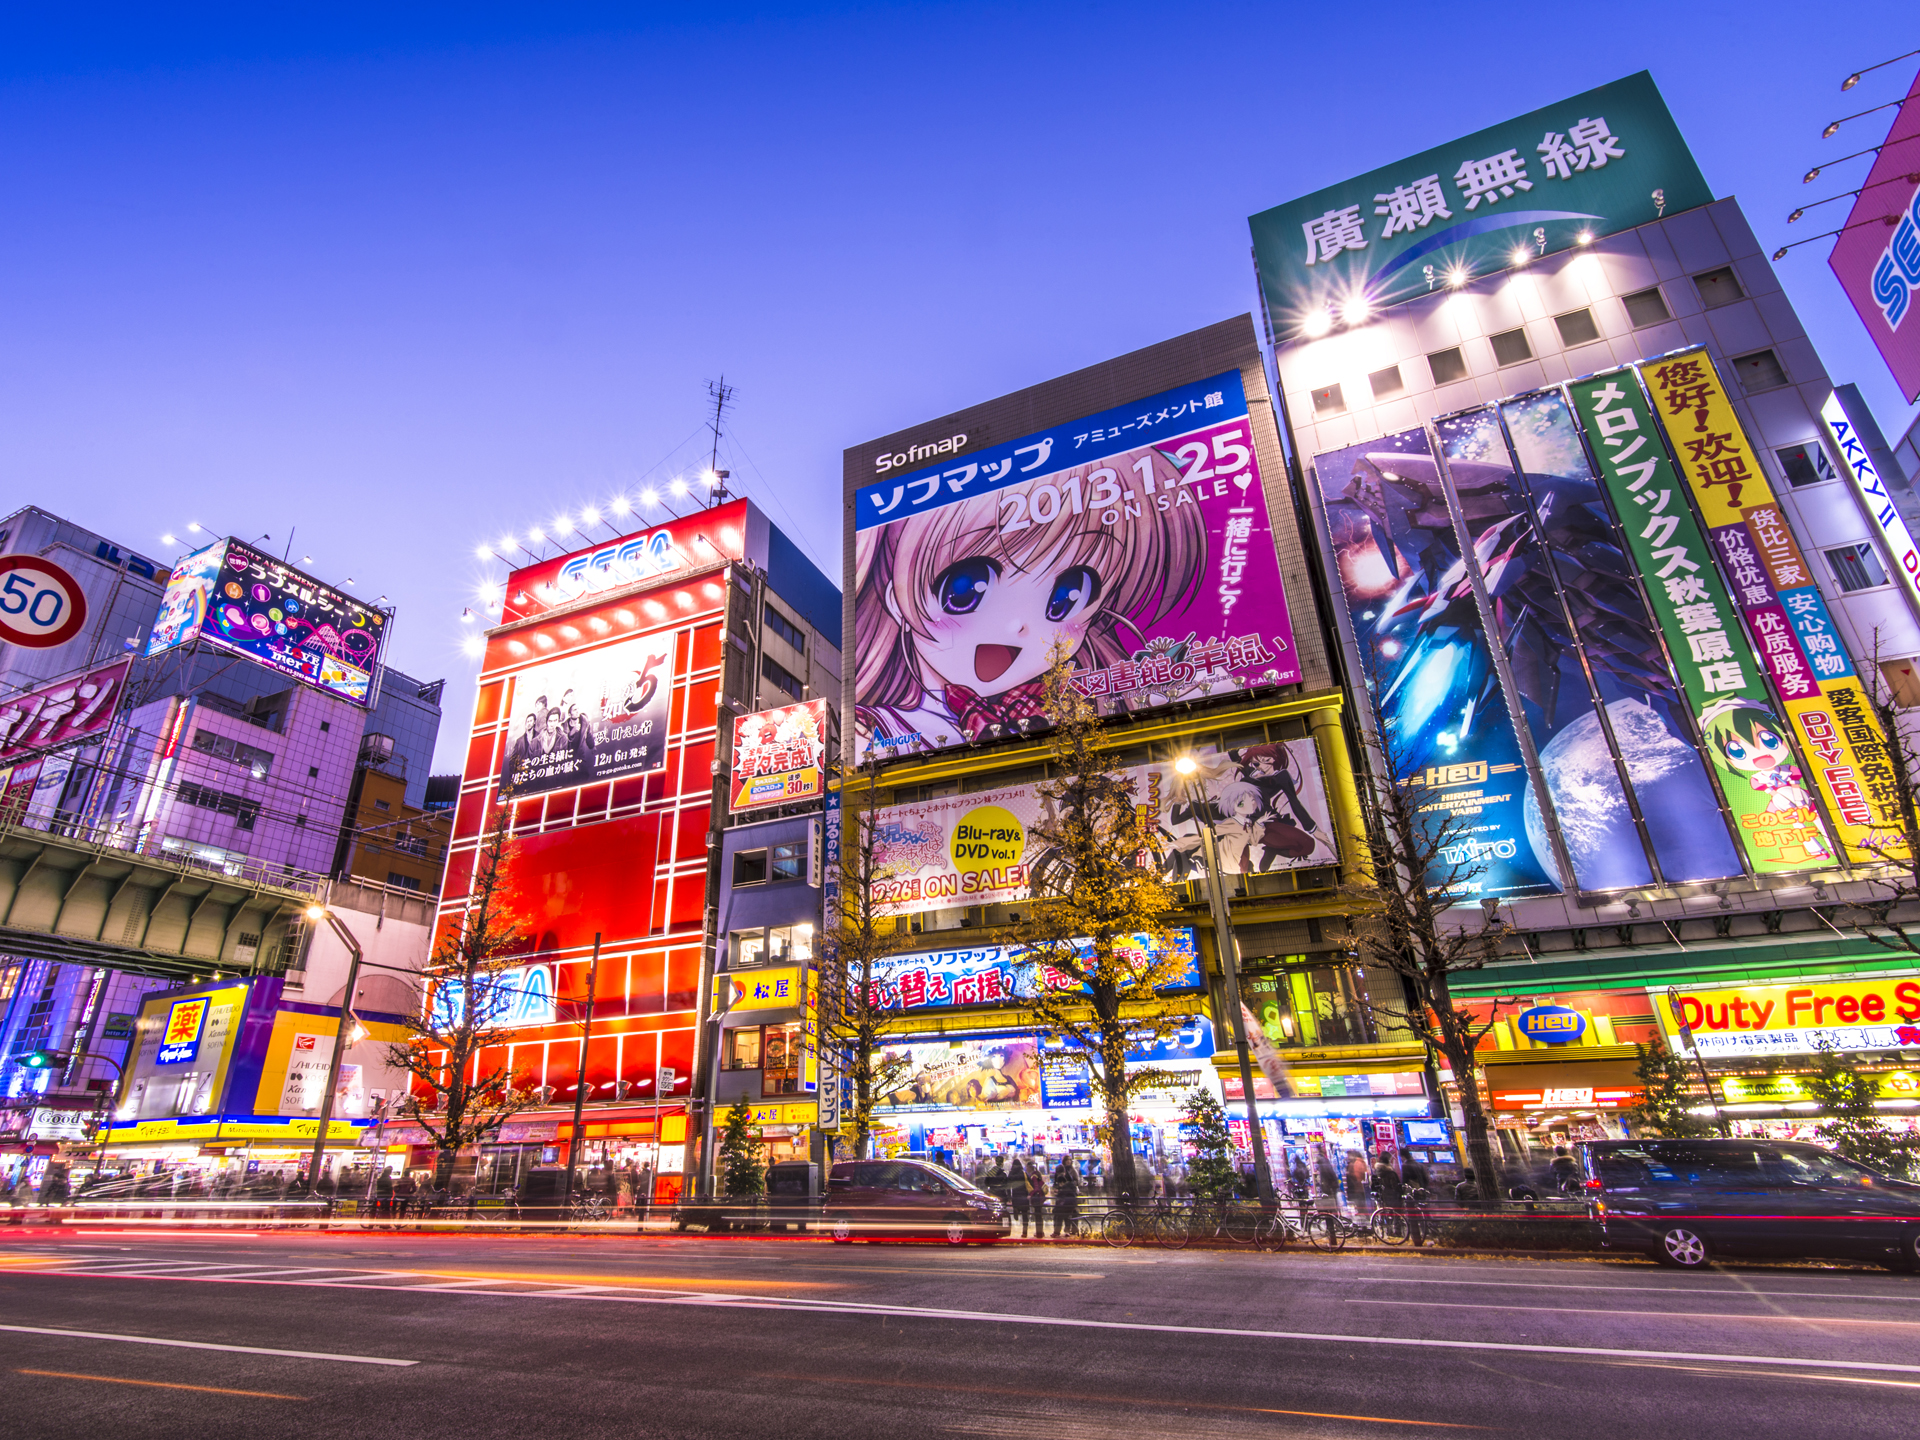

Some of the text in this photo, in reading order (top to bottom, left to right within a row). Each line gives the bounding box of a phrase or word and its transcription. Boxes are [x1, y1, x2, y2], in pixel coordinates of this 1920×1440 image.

[1301, 117, 1625, 266] 廣瀬無線
[1871, 182, 1920, 332] SE
[1073, 390, 1223, 449] アミューズメント館
[875, 433, 968, 474] Sofmap
[1830, 420, 1887, 499] AKKY
[870, 437, 1053, 515] ソフマップ
[999, 429, 1250, 535] 2013.1.25
[1101, 479, 1229, 526] ON SALE
[1592, 382, 1748, 693] メロンブックス秋葉原店
[1750, 508, 1807, 587] 货比三家
[556, 529, 681, 606] SEGA
[1218, 506, 1254, 616] 一緒に行こ?
[1718, 528, 1773, 607] 价格优惠
[0, 572, 63, 627] 50
[248, 562, 345, 616] ラブメルシー
[1787, 593, 1846, 676] 安心购物
[270, 650, 319, 677] merci
[284, 644, 321, 665] LOVE
[1754, 612, 1811, 697] 优质服务
[521, 748, 574, 767] その生き様に
[884, 731, 922, 747] AUGUST
[739, 746, 815, 779] 堂々完成!
[1426, 760, 1488, 790] Hey
[1799, 710, 1876, 827] DUTY FREE
[866, 790, 1025, 823] 構スイートでちょっとホットなブラコン妹ラブコメ!!
[1418, 793, 1512, 813] ENTERTAINMENT
[1441, 789, 1484, 802] HIROSE
[1450, 805, 1483, 816] YARD
[825, 808, 840, 861] 売るのも
[1741, 807, 1818, 829] このビル
[955, 843, 1016, 860] DVD Vol.1
[1752, 826, 1820, 849] 地下1F
[925, 874, 958, 899] ON
[962, 863, 1031, 894] SALE!
[928, 948, 1002, 967] ソフマップ
[430, 964, 557, 1034] SEGA
[753, 979, 790, 1000] 松屋
[170, 1003, 201, 1041] 薬
[1527, 1013, 1579, 1034] Hey
[1681, 996, 1776, 1031] Duty
[1785, 988, 1887, 1027] Free
[207, 1040, 227, 1050] SOFINA
[807, 1020, 817, 1060] 松屋
[1301, 1052, 1327, 1060] Sofmap
[1693, 1032, 1799, 1048] 外向け電気製品
[291, 1060, 333, 1071] SHISEID
[757, 1108, 778, 1121] 松屋
[1543, 1088, 1594, 1105] Hey
